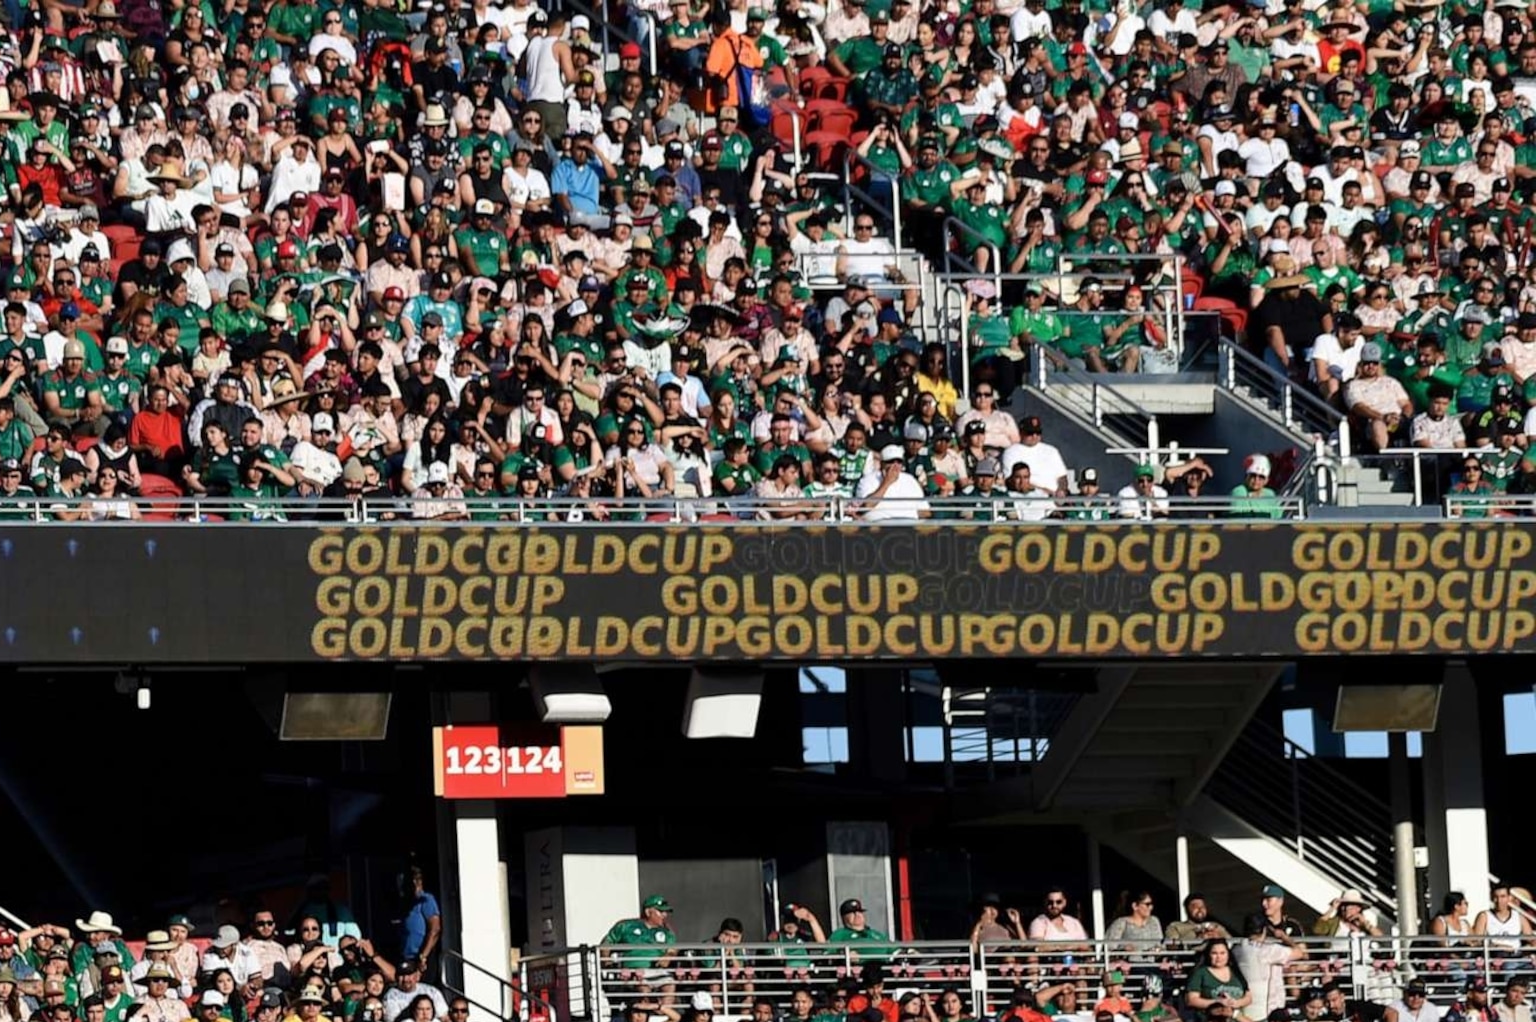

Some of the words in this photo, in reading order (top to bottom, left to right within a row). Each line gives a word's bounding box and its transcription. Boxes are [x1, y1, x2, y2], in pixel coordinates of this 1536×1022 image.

[979, 533, 1221, 573] GOLDCUP
[1292, 531, 1532, 570] GOLDCUP
[315, 575, 564, 616] GOLDCUP
[661, 574, 919, 615] GOLDCUP
[735, 614, 989, 656] GOLDCUP
[984, 612, 1225, 654] GOLDCUP
[1295, 611, 1535, 651] GOLDCUP
[446, 745, 502, 774] 123
[507, 745, 562, 774] 124
